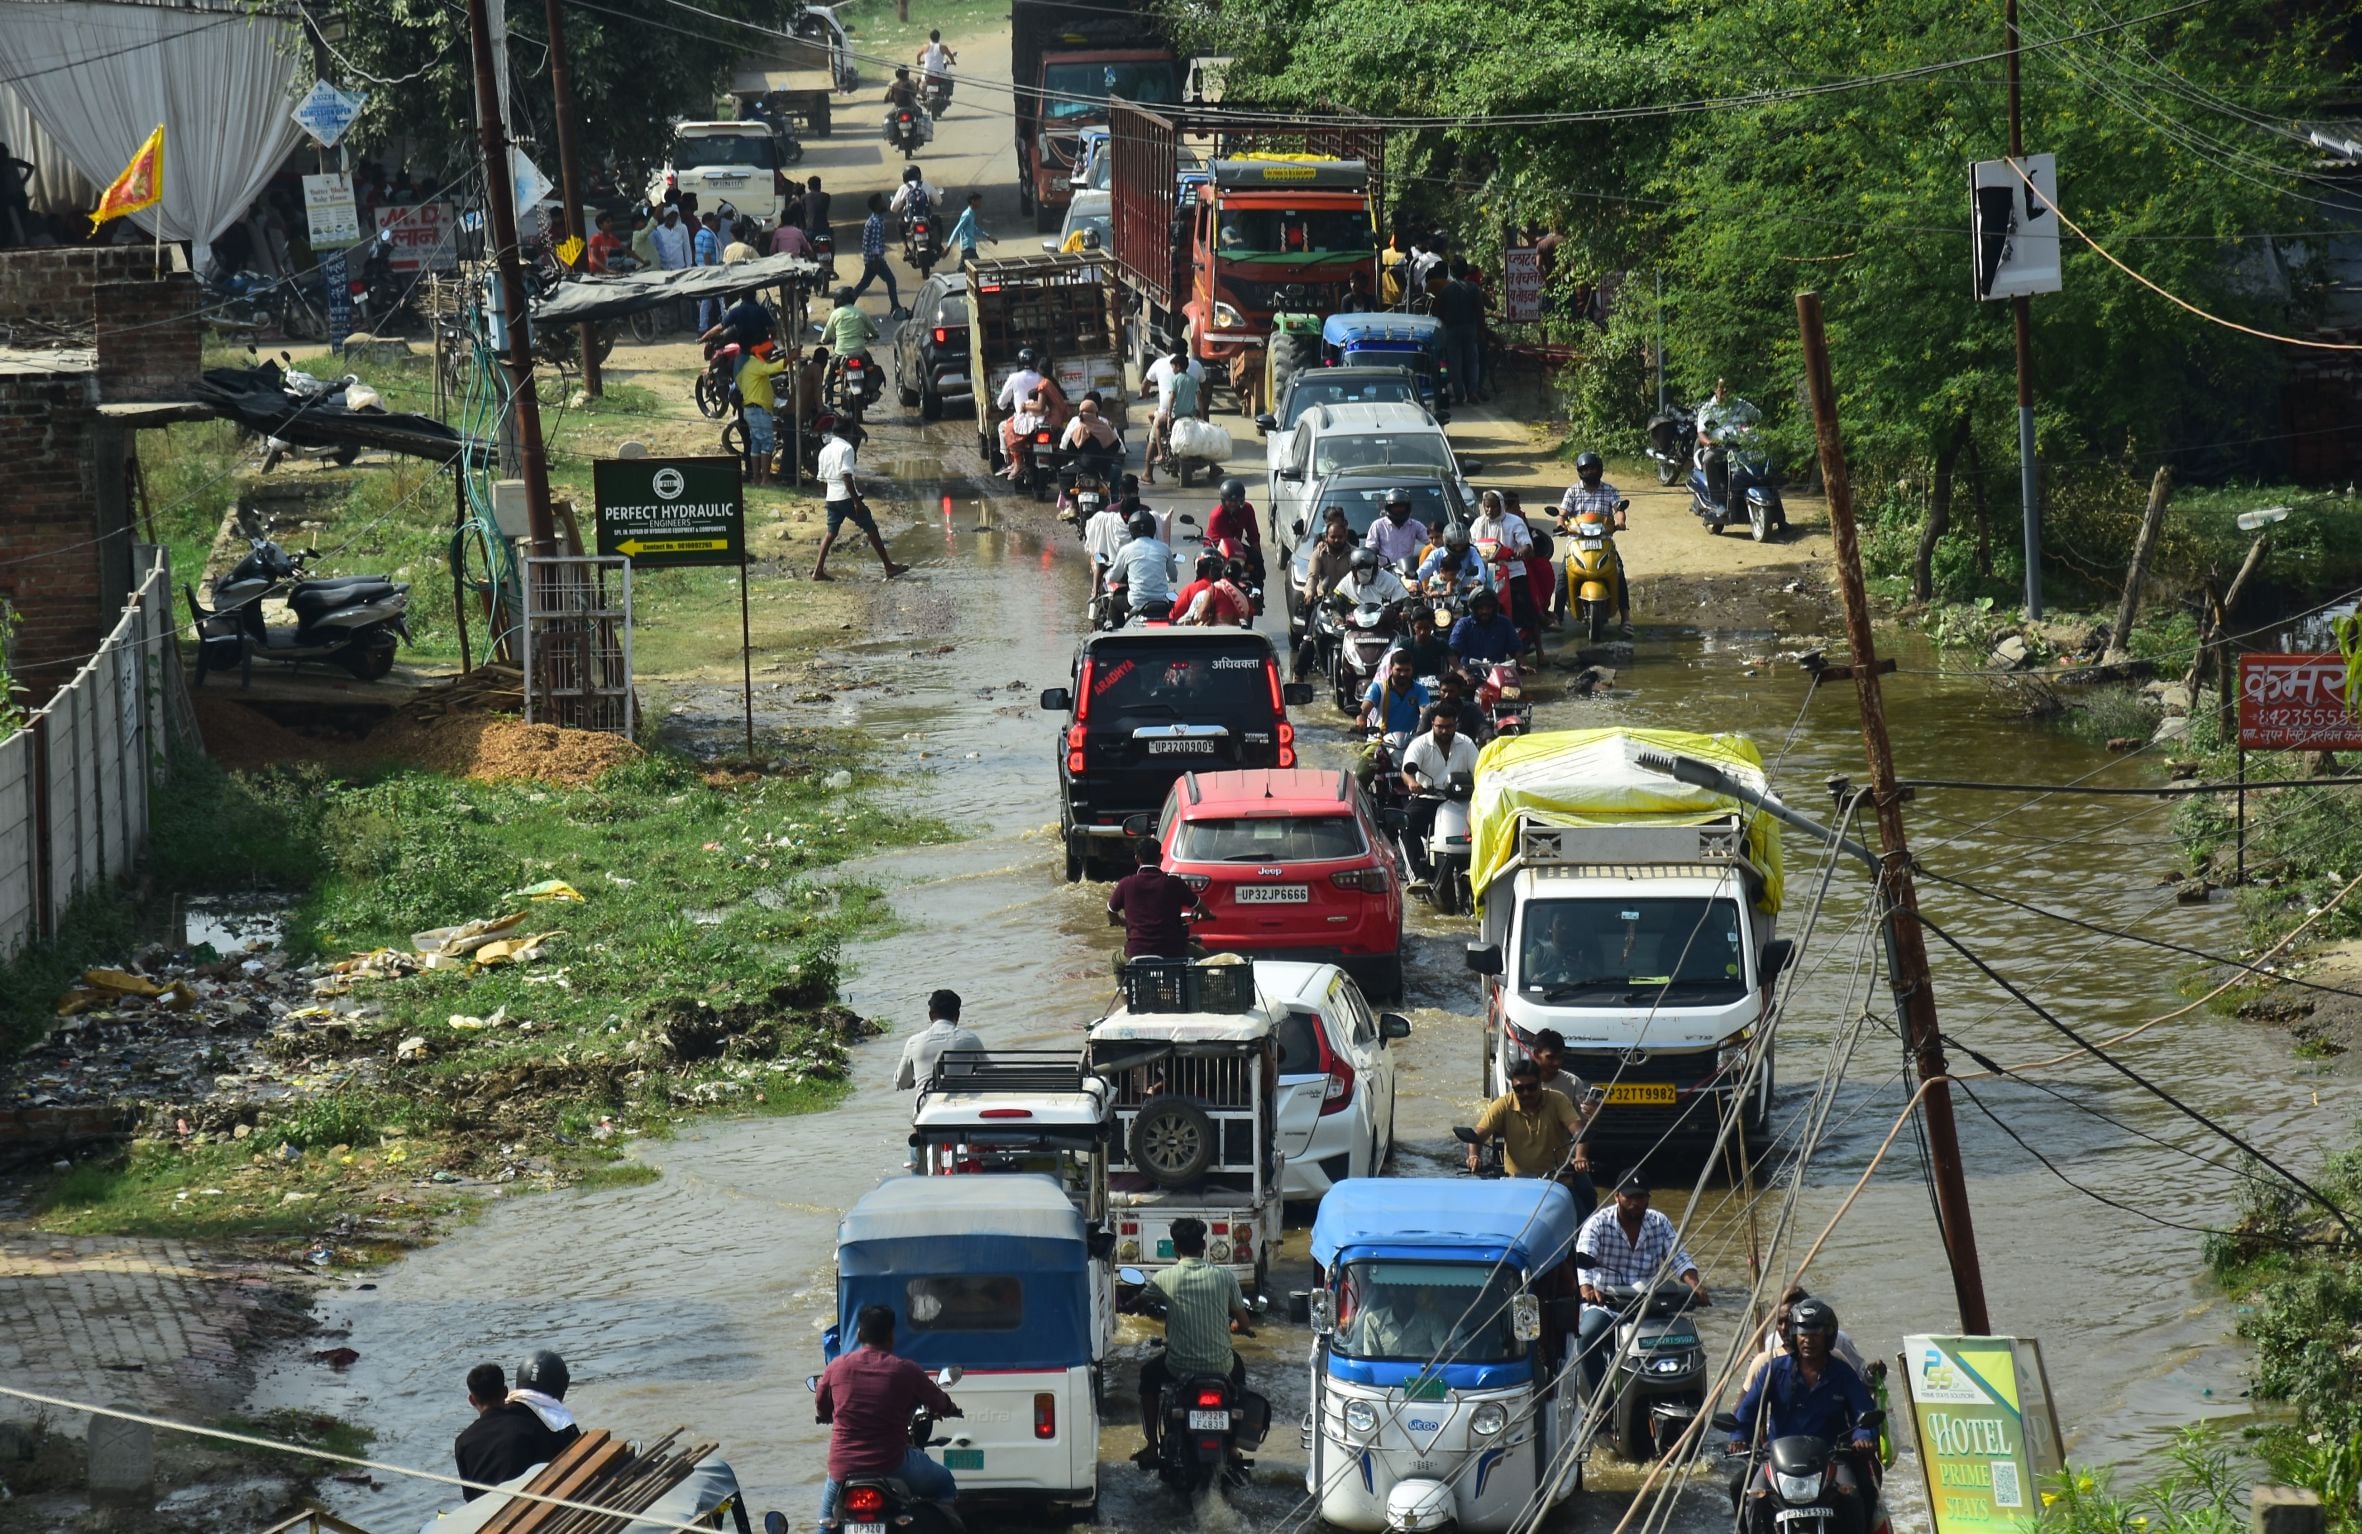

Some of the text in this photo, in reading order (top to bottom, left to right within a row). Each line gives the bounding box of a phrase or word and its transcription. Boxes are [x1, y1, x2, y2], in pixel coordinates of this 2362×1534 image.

[605, 503, 734, 521] PERFECT HYDRAULIC
[649, 518, 691, 528] ENGINEERS
[699, 525, 727, 533] COMPONENTS
[642, 543, 665, 551] Contact
[1211, 656, 1259, 670] अधिवक्ता
[1094, 658, 1136, 696] ARADHYA
[1257, 866, 1282, 876] Jeep
[1241, 888, 1307, 901] UP32JP6666
[1603, 1087, 1675, 1101] P32TT9982
[1196, 1411, 1224, 1420] UP32R
[1409, 1420, 1438, 1431] WEGO
[1927, 1412, 2013, 1457] HOTEL
[1939, 1463, 1991, 1488] PRIME
[1946, 1497, 1990, 1521] STAYS
